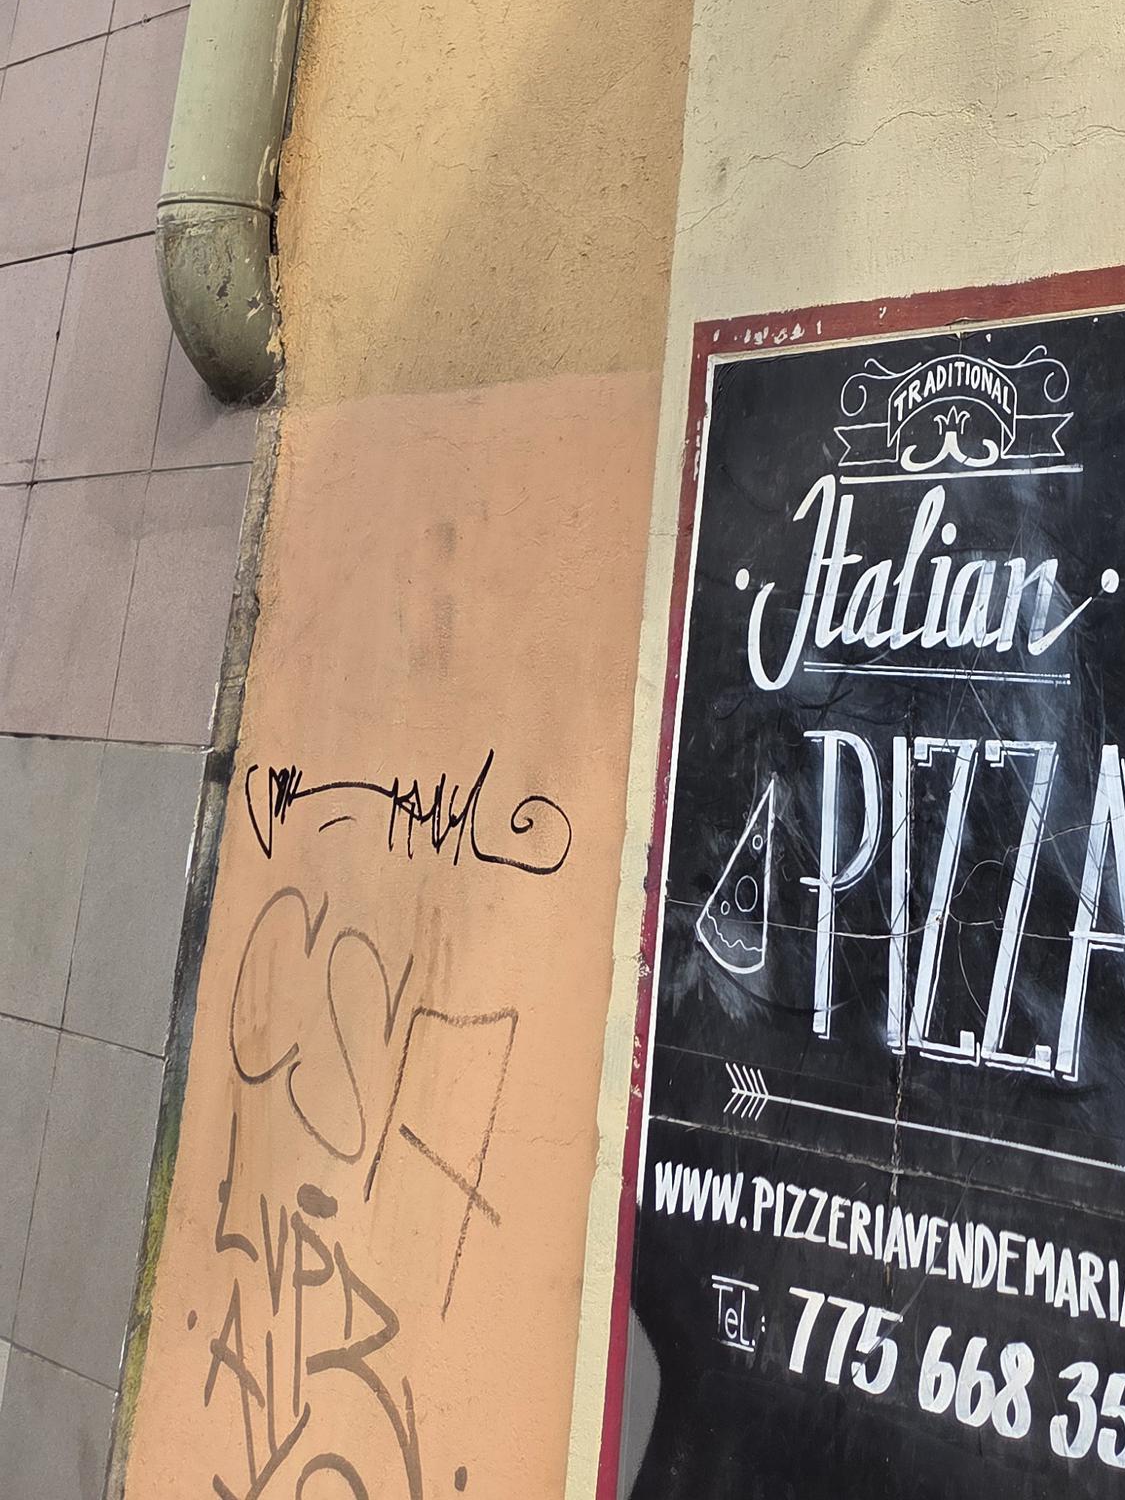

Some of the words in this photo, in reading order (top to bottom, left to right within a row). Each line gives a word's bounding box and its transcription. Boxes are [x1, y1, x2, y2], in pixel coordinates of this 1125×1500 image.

[893, 361, 1012, 422] TRADITIONAL
[747, 473, 1092, 691] Italian
[788, 1286, 904, 1395] 775
[917, 1325, 1036, 1440] 668
